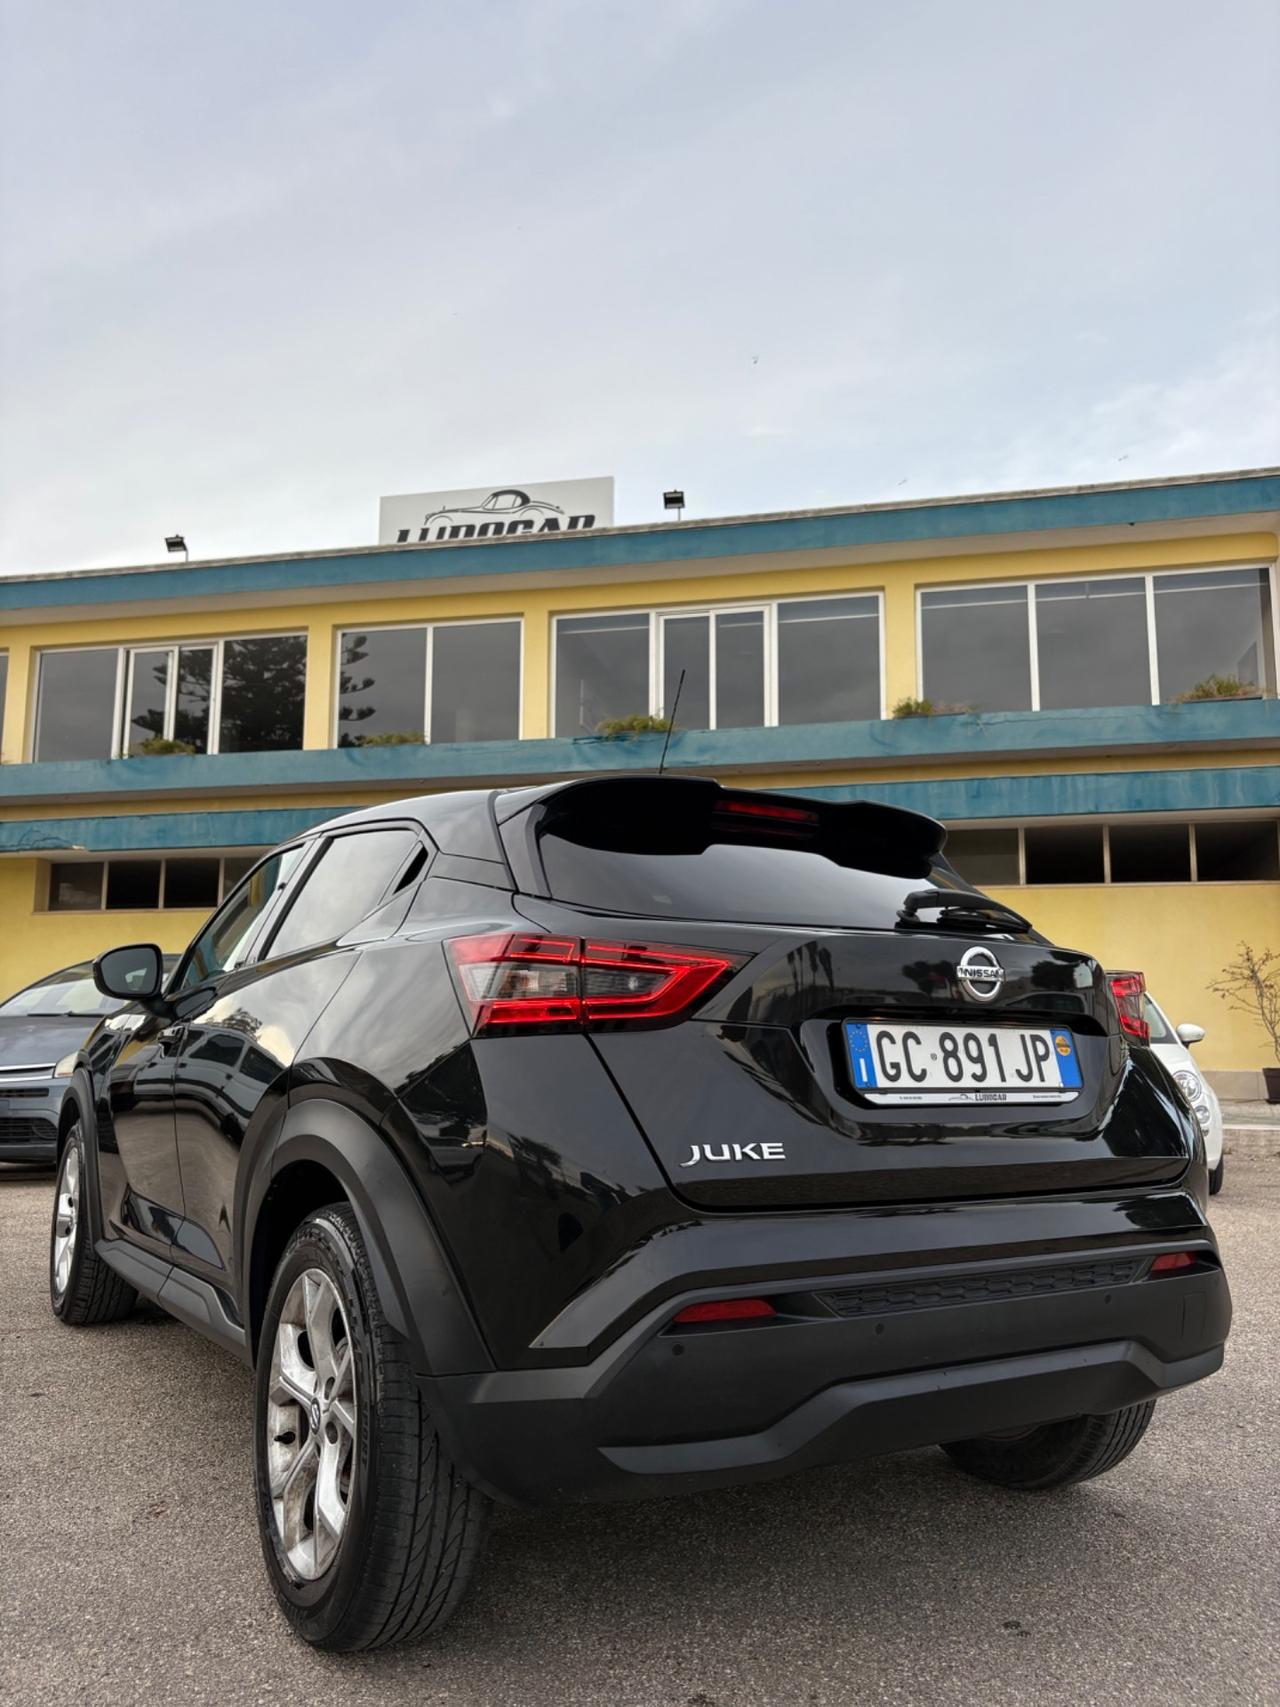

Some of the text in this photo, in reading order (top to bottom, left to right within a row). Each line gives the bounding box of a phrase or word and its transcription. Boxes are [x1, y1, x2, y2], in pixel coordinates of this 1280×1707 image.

[876, 1030, 1050, 1083] GC 891 JP
[680, 1142, 787, 1168] JUKE
